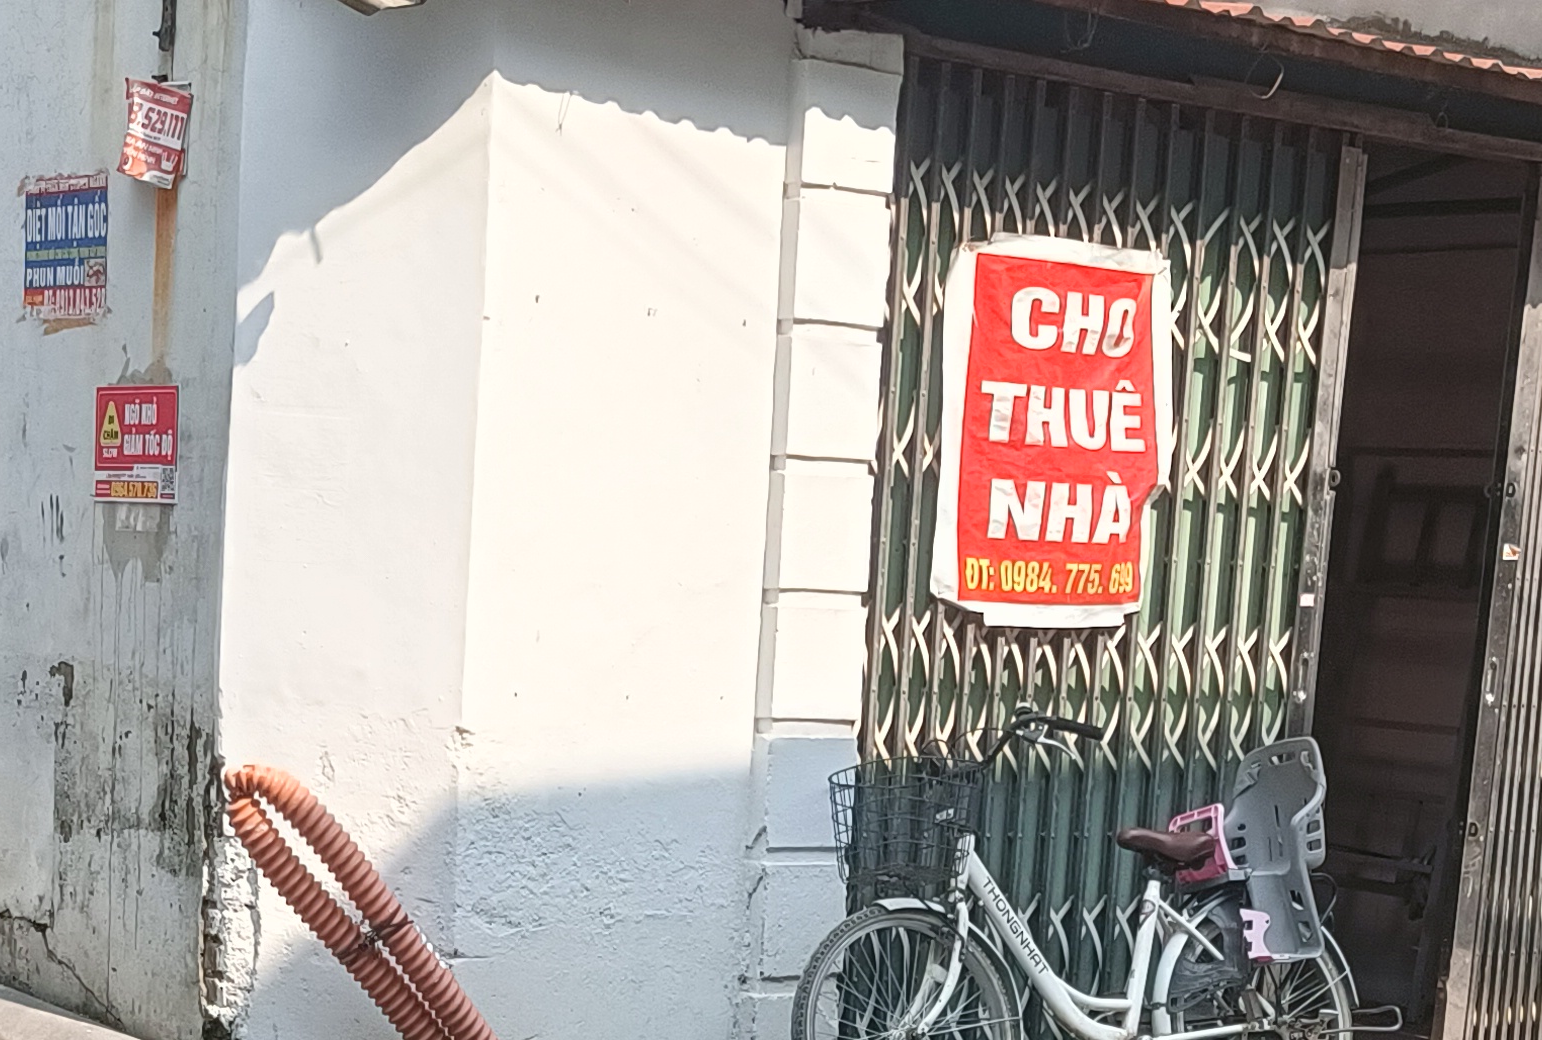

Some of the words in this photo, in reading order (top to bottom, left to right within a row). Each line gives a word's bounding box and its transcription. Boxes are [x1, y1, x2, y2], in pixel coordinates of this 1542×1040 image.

[26, 200, 46, 249] DIỆT
[47, 194, 66, 241] MỐI
[67, 197, 86, 247] TẬN
[87, 190, 107, 238] GỐC
[26, 266, 54, 288] PHUN
[1010, 286, 1137, 358] CHO
[981, 380, 1146, 452] THUÊ
[987, 471, 1132, 544] NHÀ
[965, 557, 995, 590] ĐT:
